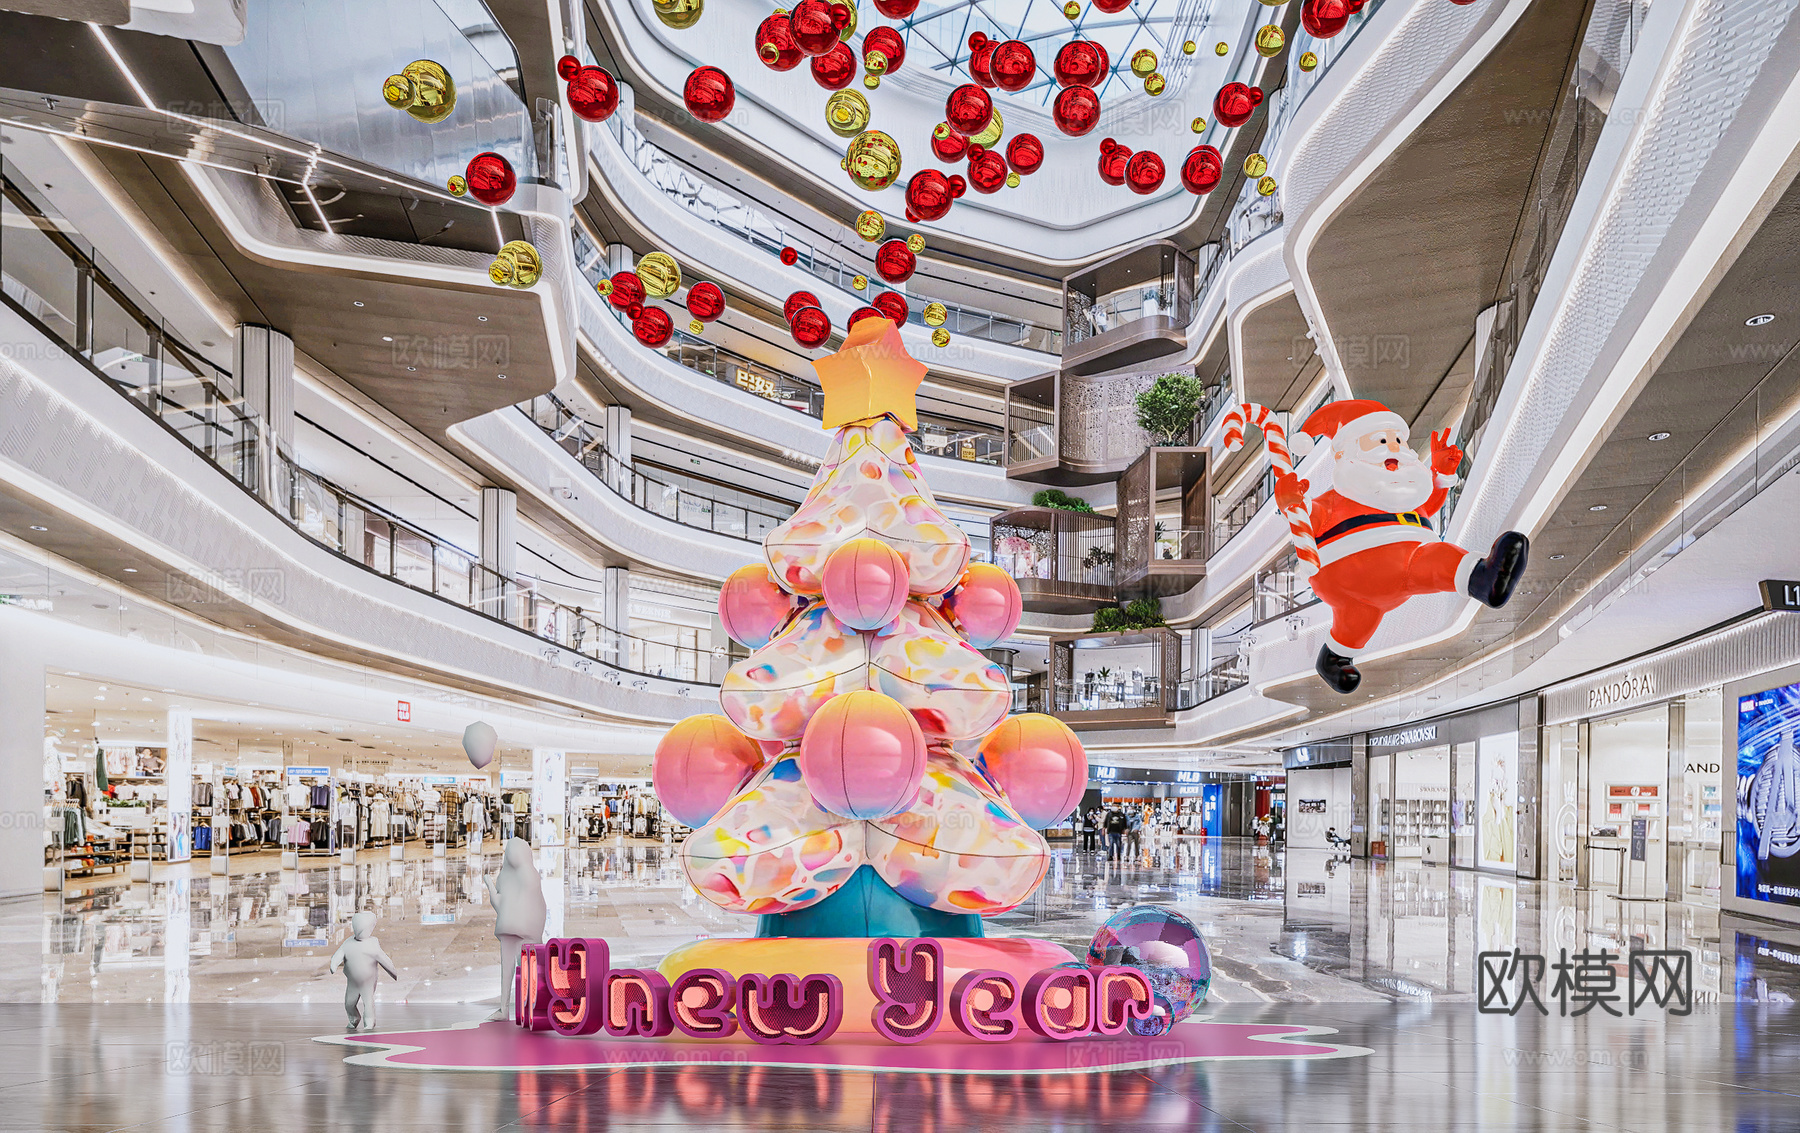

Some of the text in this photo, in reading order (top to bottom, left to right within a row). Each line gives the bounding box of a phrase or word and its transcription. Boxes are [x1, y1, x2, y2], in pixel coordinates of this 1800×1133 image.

[1400, 725, 1437, 745] SWAROVSKI
[1096, 766, 1116, 779] MLB
[1684, 763, 1720, 774] AND
[1177, 771, 1200, 783] MLB
[603, 968, 844, 1045] new
[867, 937, 1154, 1044] Year
